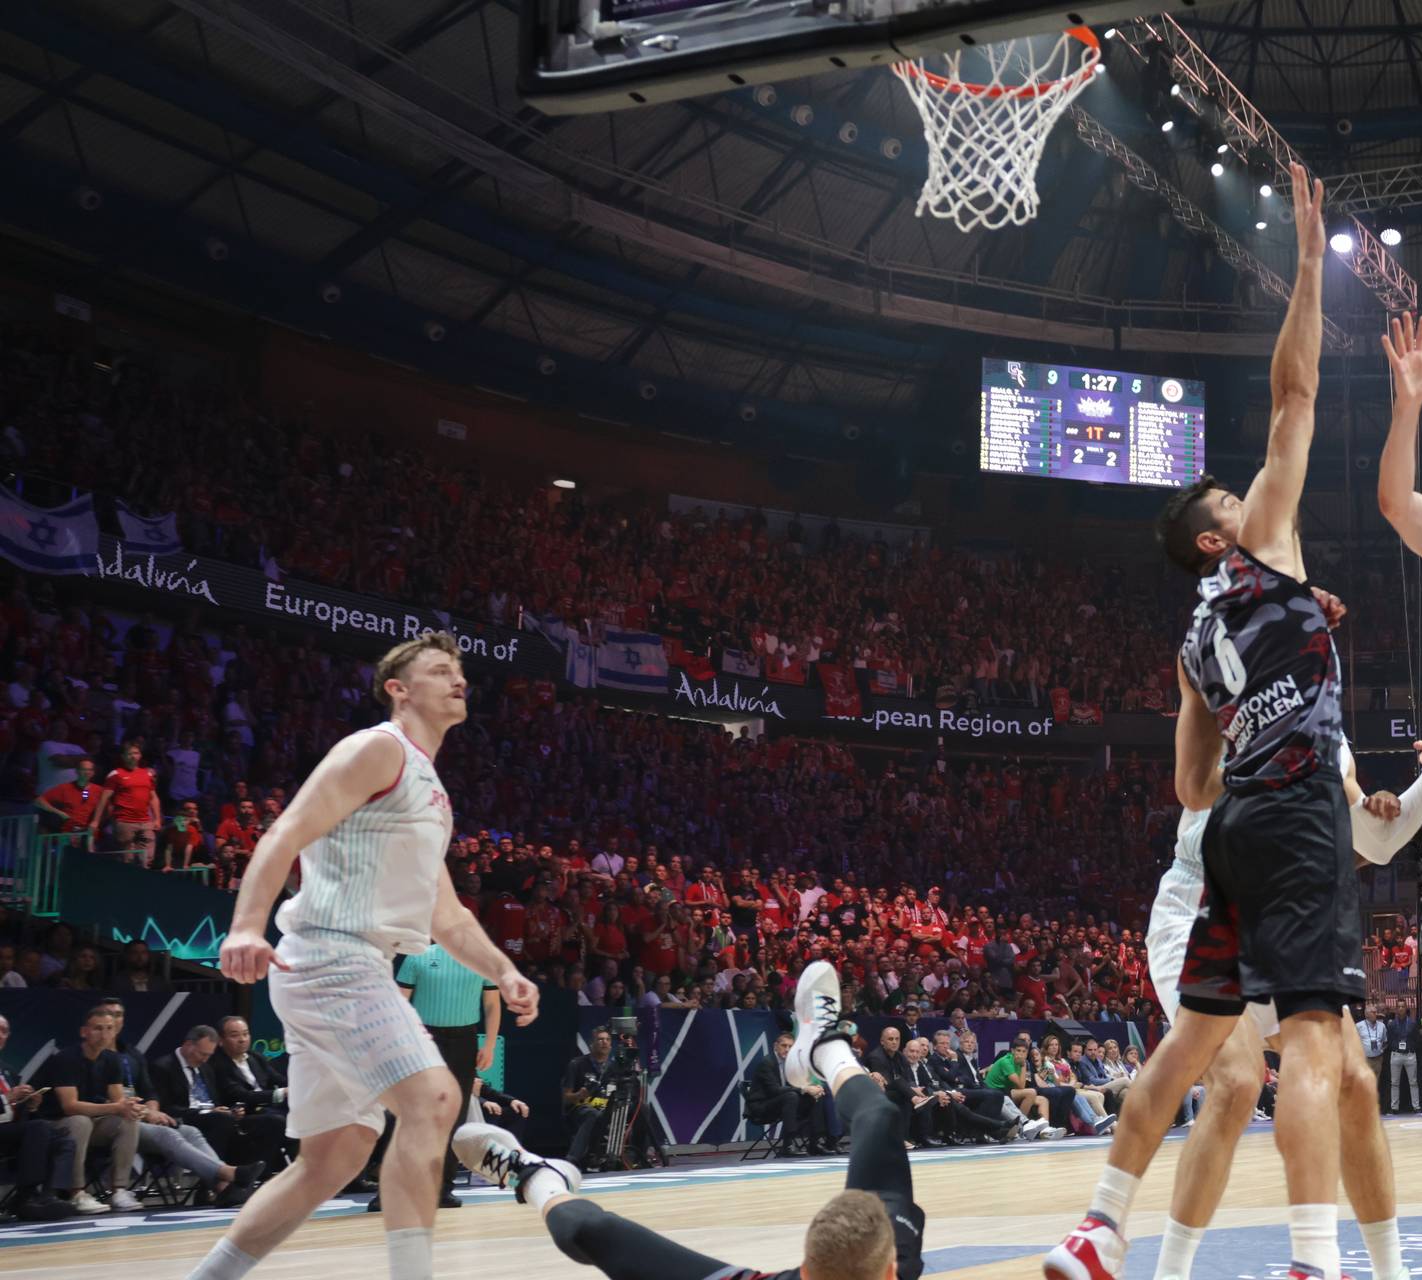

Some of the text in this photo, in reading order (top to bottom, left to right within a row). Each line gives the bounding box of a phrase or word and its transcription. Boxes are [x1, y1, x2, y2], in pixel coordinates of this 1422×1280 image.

[1047, 370, 1142, 393] 9 1:27 5
[1086, 426, 1104, 440] 1T
[1073, 448, 1084, 464] 2
[1106, 451, 1117, 466] 2
[265, 581, 397, 637] European
[494, 638, 518, 662] of
[674, 671, 787, 720] Andalucía
[940, 710, 1022, 737] Region
[1028, 717, 1053, 736] of
